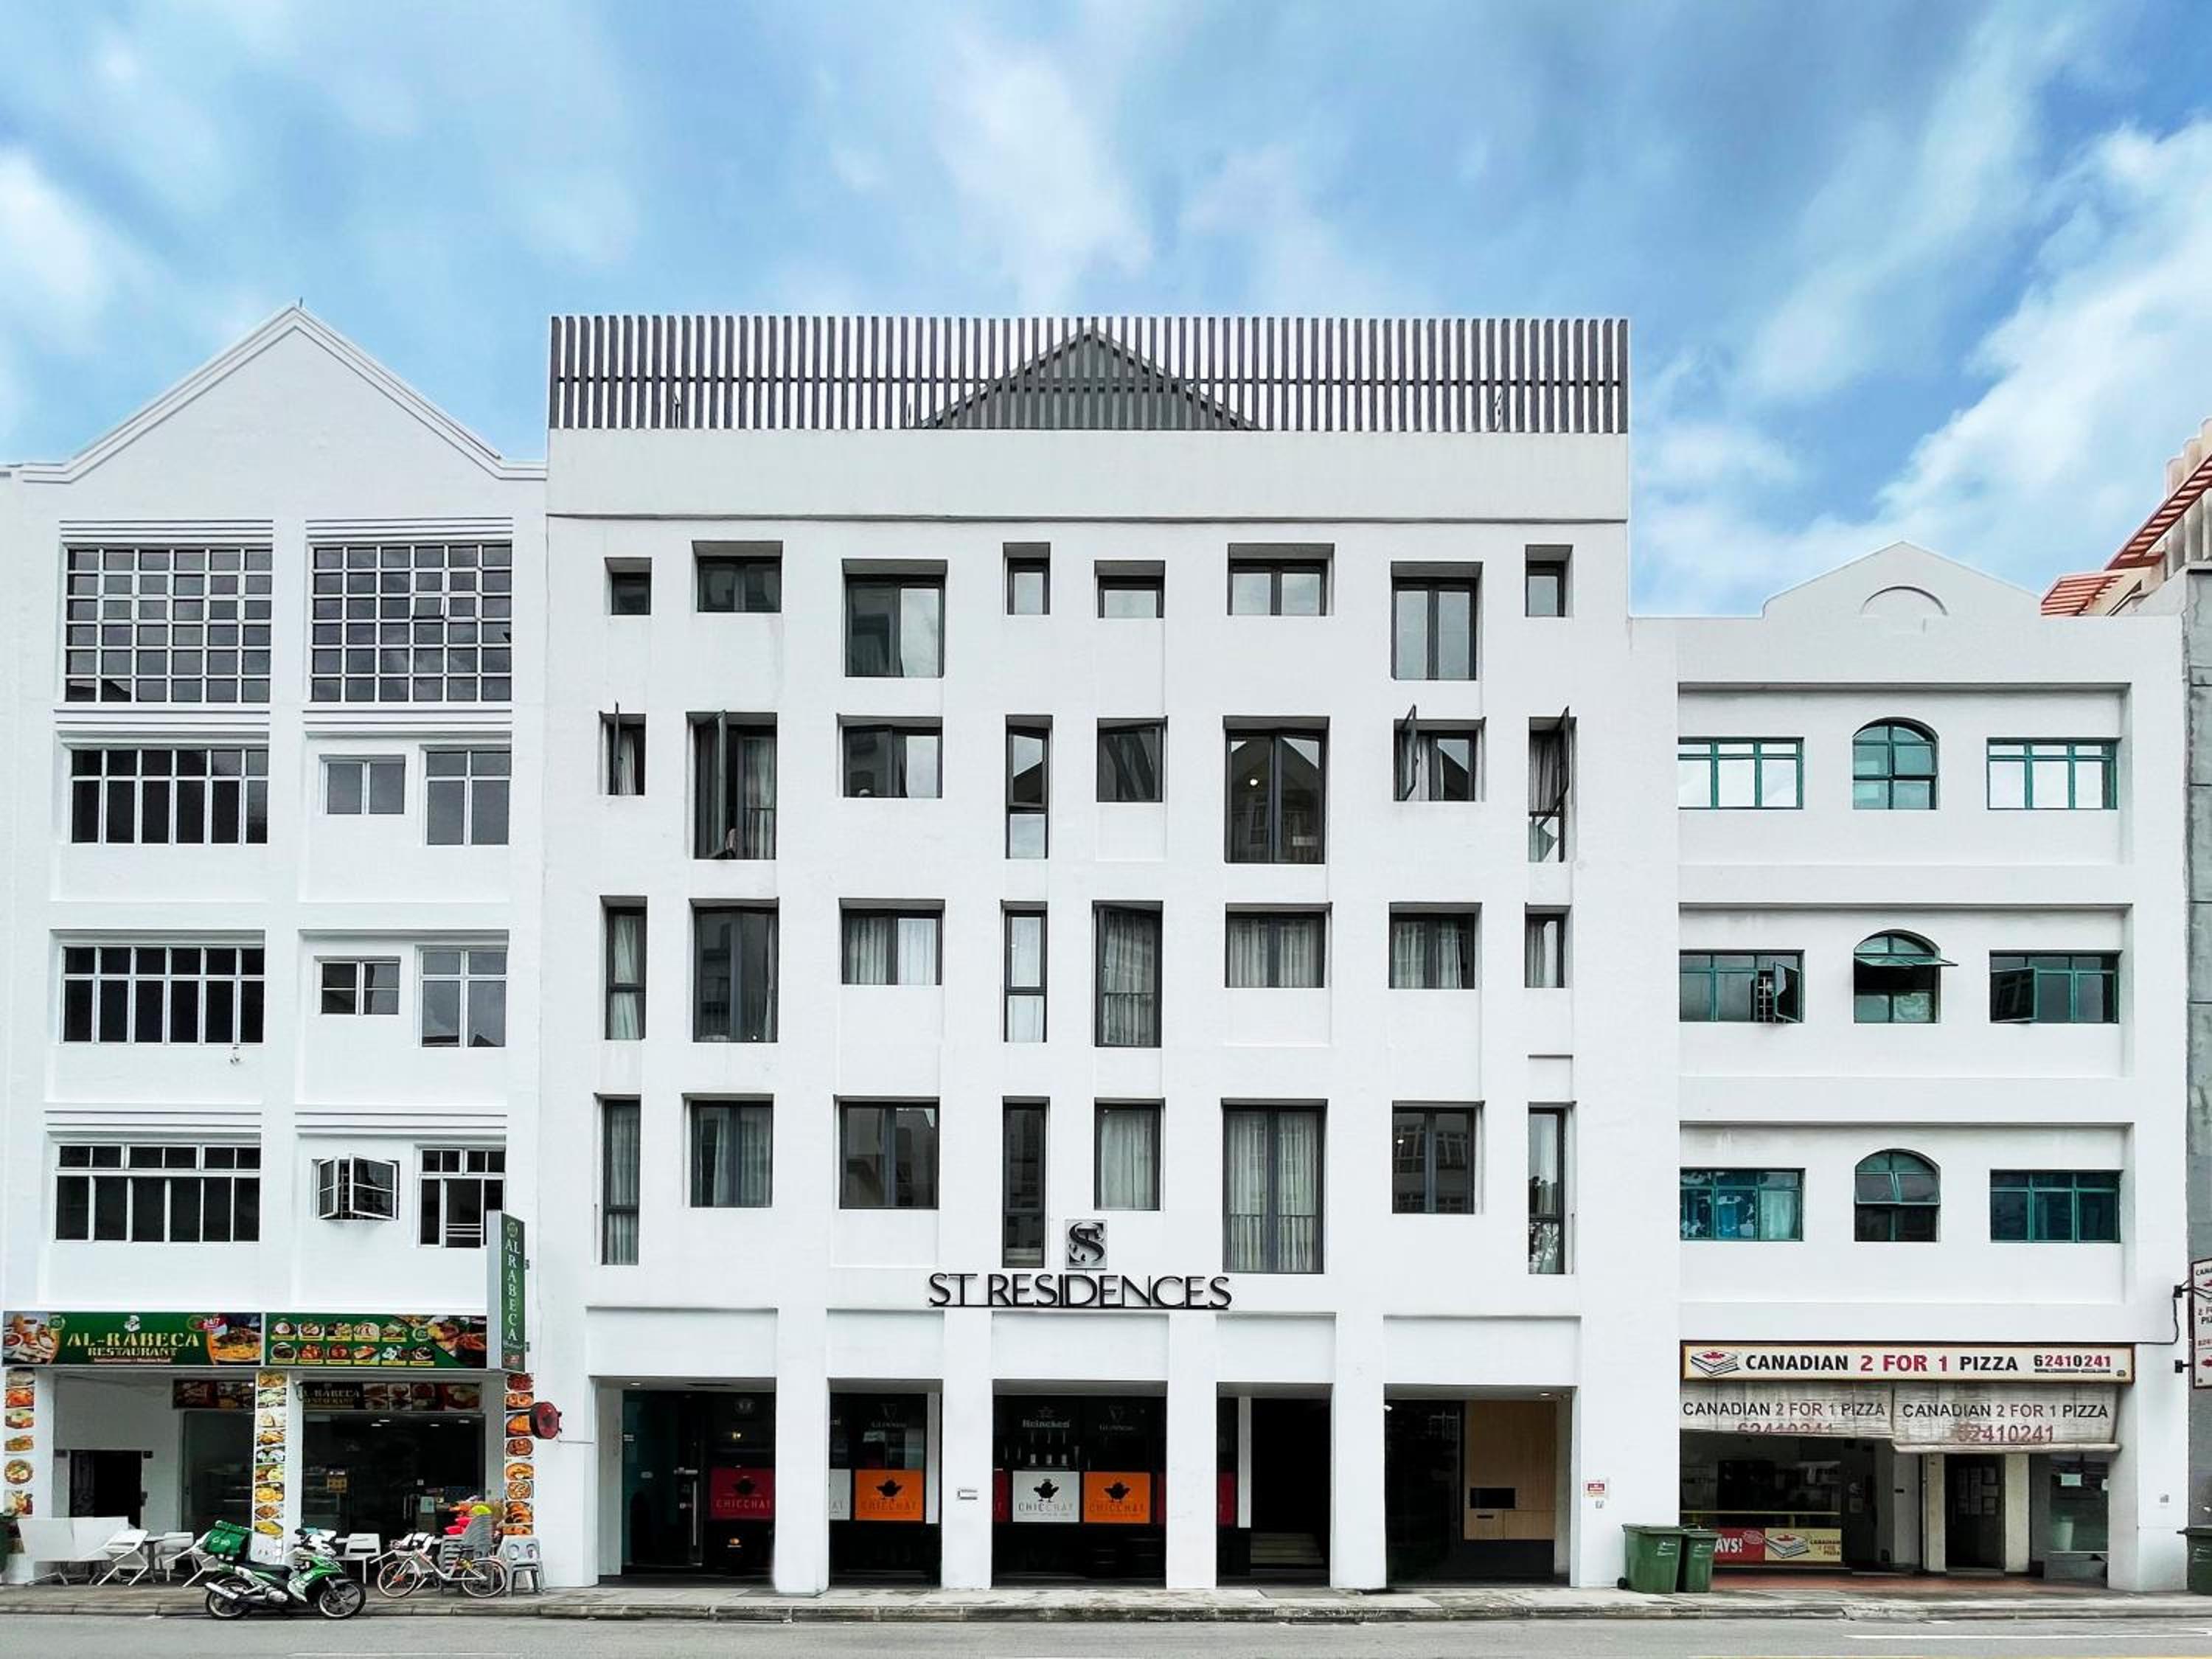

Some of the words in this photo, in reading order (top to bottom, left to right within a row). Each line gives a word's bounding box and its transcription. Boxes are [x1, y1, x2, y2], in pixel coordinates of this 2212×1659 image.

[505, 1239, 521, 1254] AL
[507, 1254, 518, 1342] RABECA
[928, 1272, 978, 1307] ST
[987, 1273, 1233, 1309] RESIDENCES
[66, 1332, 200, 1348] AL-RABECA
[87, 1347, 178, 1357] RESTAURANT
[1745, 1354, 1849, 1371] CANADIAN
[1860, 1355, 1874, 1371] 2
[1882, 1354, 1928, 1372] FOR
[1938, 1355, 1948, 1372] 1
[1959, 1356, 2019, 1371] PIZZA
[2034, 1354, 2111, 1368] 62410241
[1683, 1402, 1770, 1416] CANADIAN
[1775, 1402, 1784, 1416] 2
[1789, 1402, 1823, 1416] FOR
[1829, 1403, 1834, 1416] 1
[1841, 1402, 1885, 1416] PIZZA
[1902, 1404, 1991, 1417] CANADIAN
[1996, 1405, 2006, 1417] 2
[2010, 1405, 2044, 1417] FOR
[2050, 1405, 2056, 1417] 1
[2062, 1405, 2108, 1417] PIZZA
